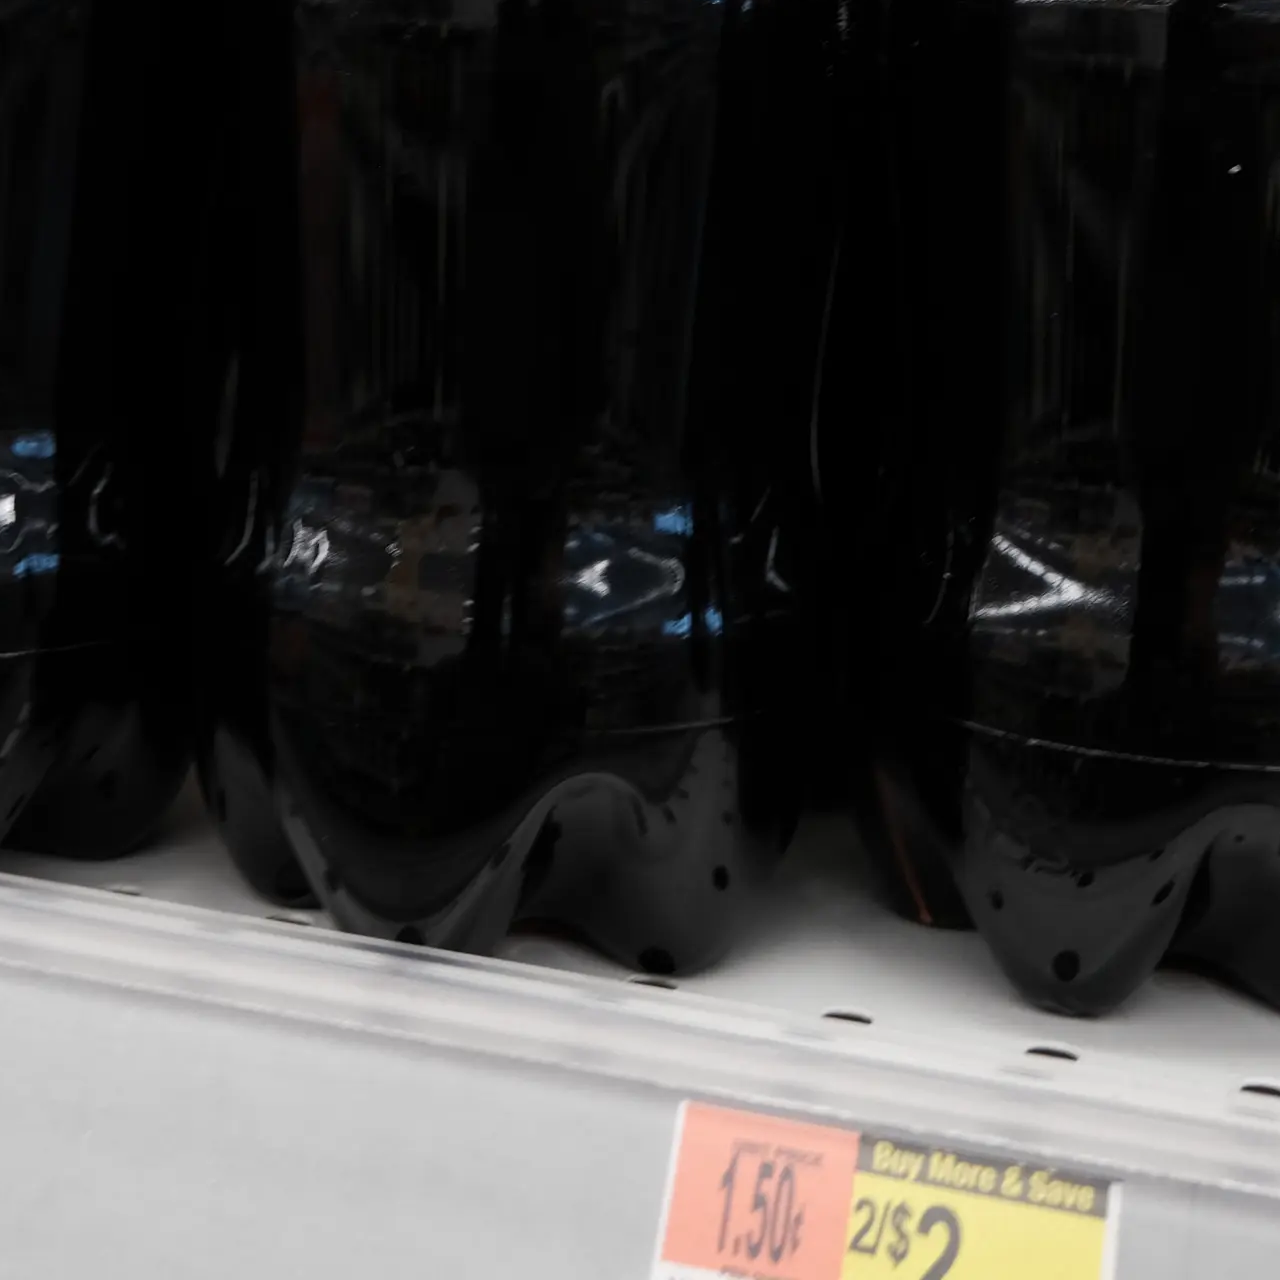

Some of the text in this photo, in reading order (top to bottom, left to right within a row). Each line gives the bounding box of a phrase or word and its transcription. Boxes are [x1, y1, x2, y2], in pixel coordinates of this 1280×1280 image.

[872, 1139, 925, 1182] Buy
[927, 1149, 999, 1193] More
[1000, 1165, 1024, 1198] &
[1027, 1169, 1097, 1212] Save
